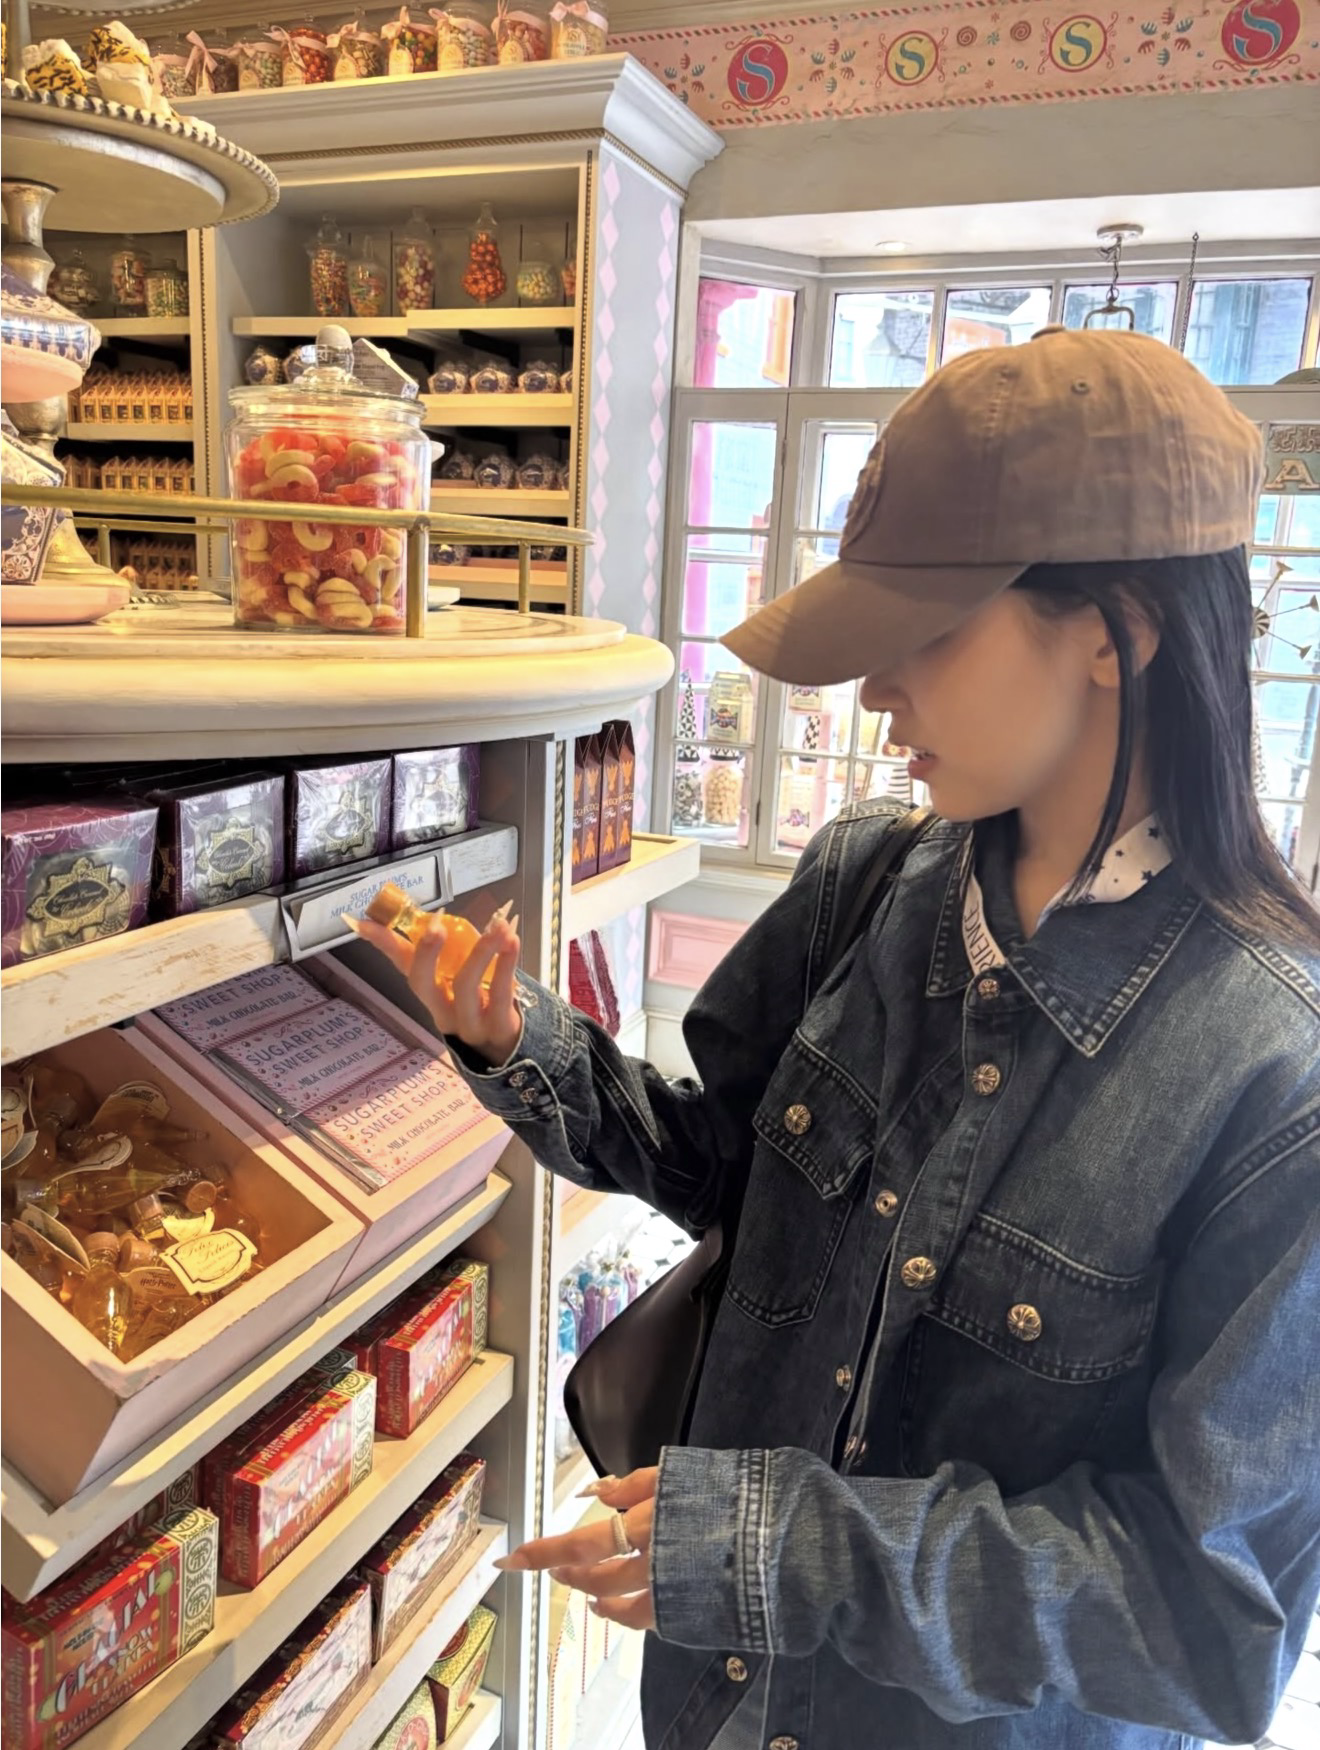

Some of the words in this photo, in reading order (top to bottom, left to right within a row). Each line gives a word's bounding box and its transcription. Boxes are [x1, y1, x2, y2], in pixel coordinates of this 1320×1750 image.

[895, 37, 926, 80] S
[1060, 21, 1092, 67] S
[736, 44, 775, 101] S
[351, 884, 379, 903] SUGAR
[406, 876, 425, 889] BAR
[181, 988, 241, 1014] SWEET
[242, 974, 282, 995] SHOP
[206, 1014, 227, 1028] MILK
[228, 997, 279, 1021] CHOCOLATE
[246, 1011, 359, 1066] SUGARPLUM'S
[272, 1043, 328, 1075] SWEET
[326, 1026, 363, 1050] SHOP
[298, 1073, 321, 1088] MILK
[319, 1051, 365, 1079] CHOCOLATE
[333, 1064, 442, 1132] SUGARPLUM'S
[360, 1103, 413, 1139] SWEET
[411, 1081, 448, 1107] SHOP
[387, 1134, 410, 1151] MILK
[407, 1108, 450, 1140] CHOCOLATE
[448, 1098, 465, 1113] BAR
